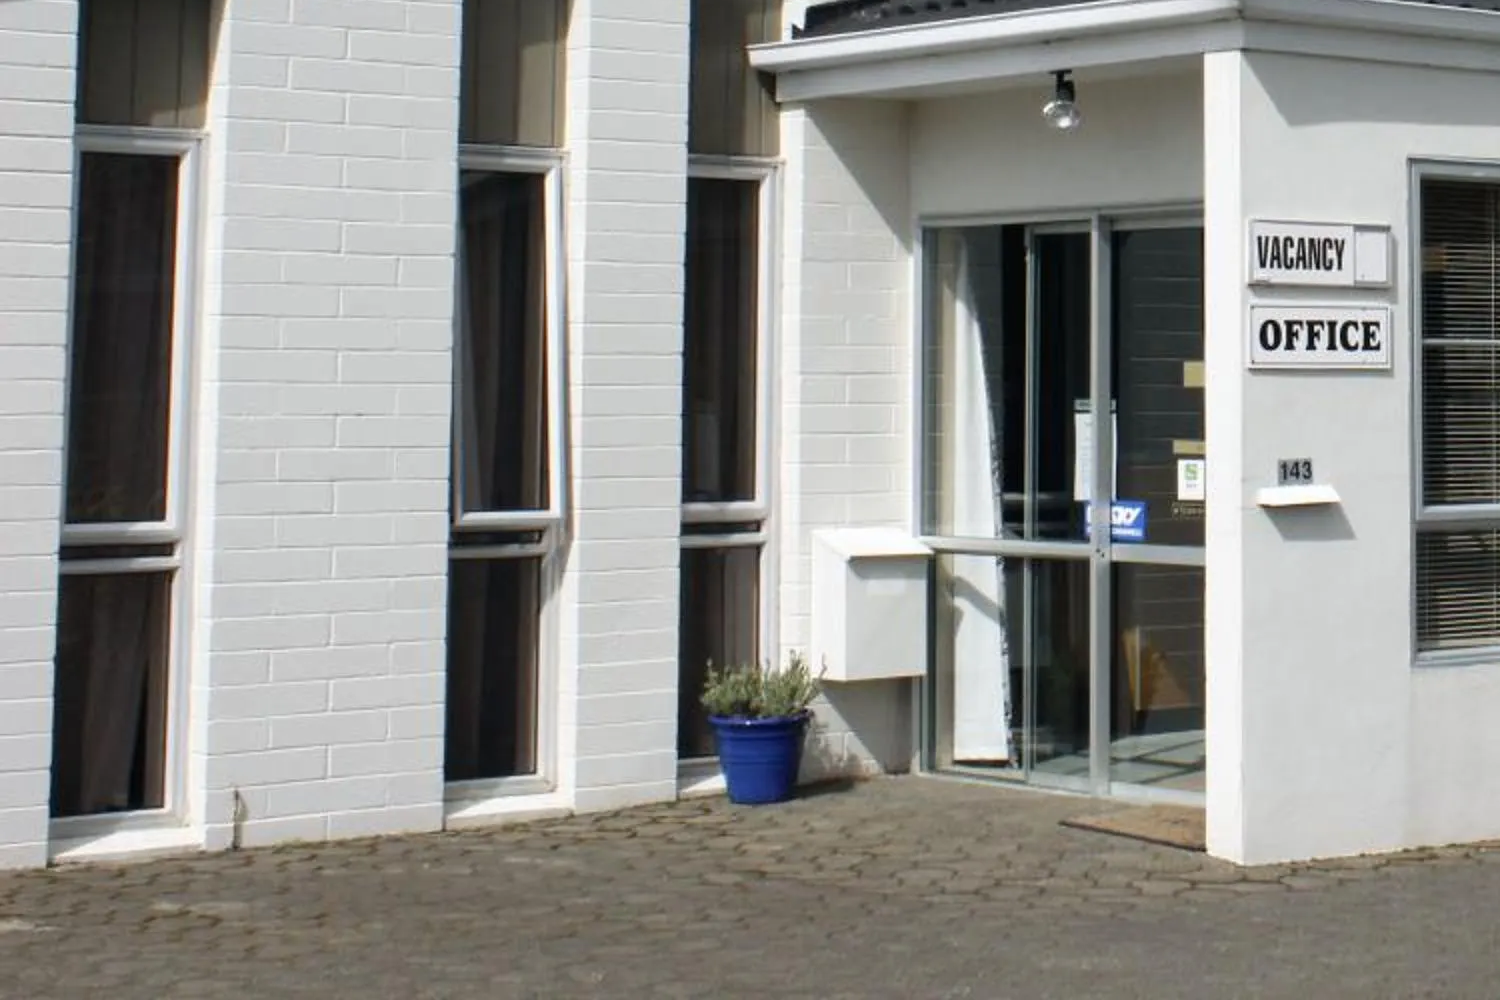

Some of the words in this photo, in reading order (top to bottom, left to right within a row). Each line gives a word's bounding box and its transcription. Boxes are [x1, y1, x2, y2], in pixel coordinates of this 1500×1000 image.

[1257, 235, 1346, 272] VACANCY
[1259, 319, 1381, 352] OFFICE
[1280, 460, 1313, 481] 143
